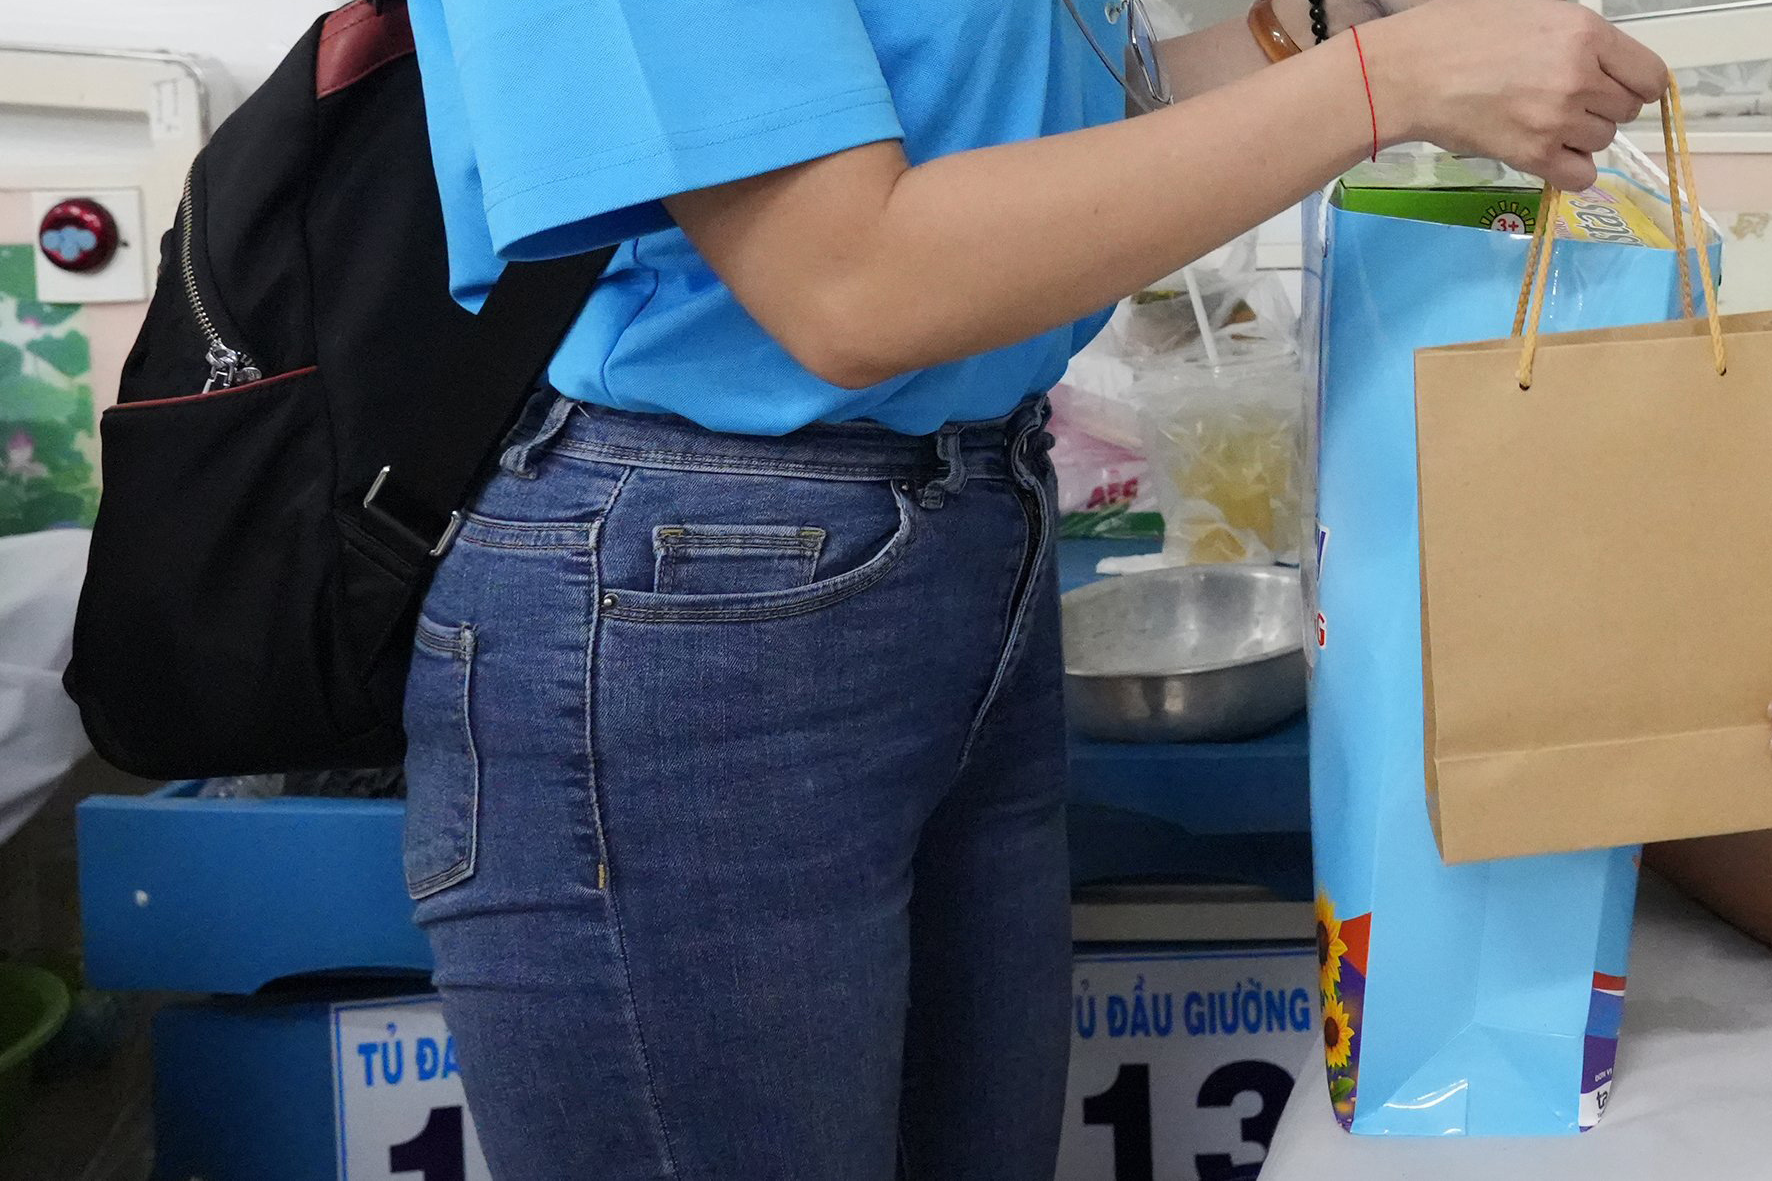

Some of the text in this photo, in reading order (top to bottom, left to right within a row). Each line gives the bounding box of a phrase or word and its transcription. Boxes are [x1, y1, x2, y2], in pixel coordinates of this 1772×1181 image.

[1072, 977, 1097, 1039] Ủ
[1183, 977, 1312, 1036] GIƯỜNG
[357, 1021, 404, 1087] TỦ
[1082, 1059, 1296, 1181] 13
